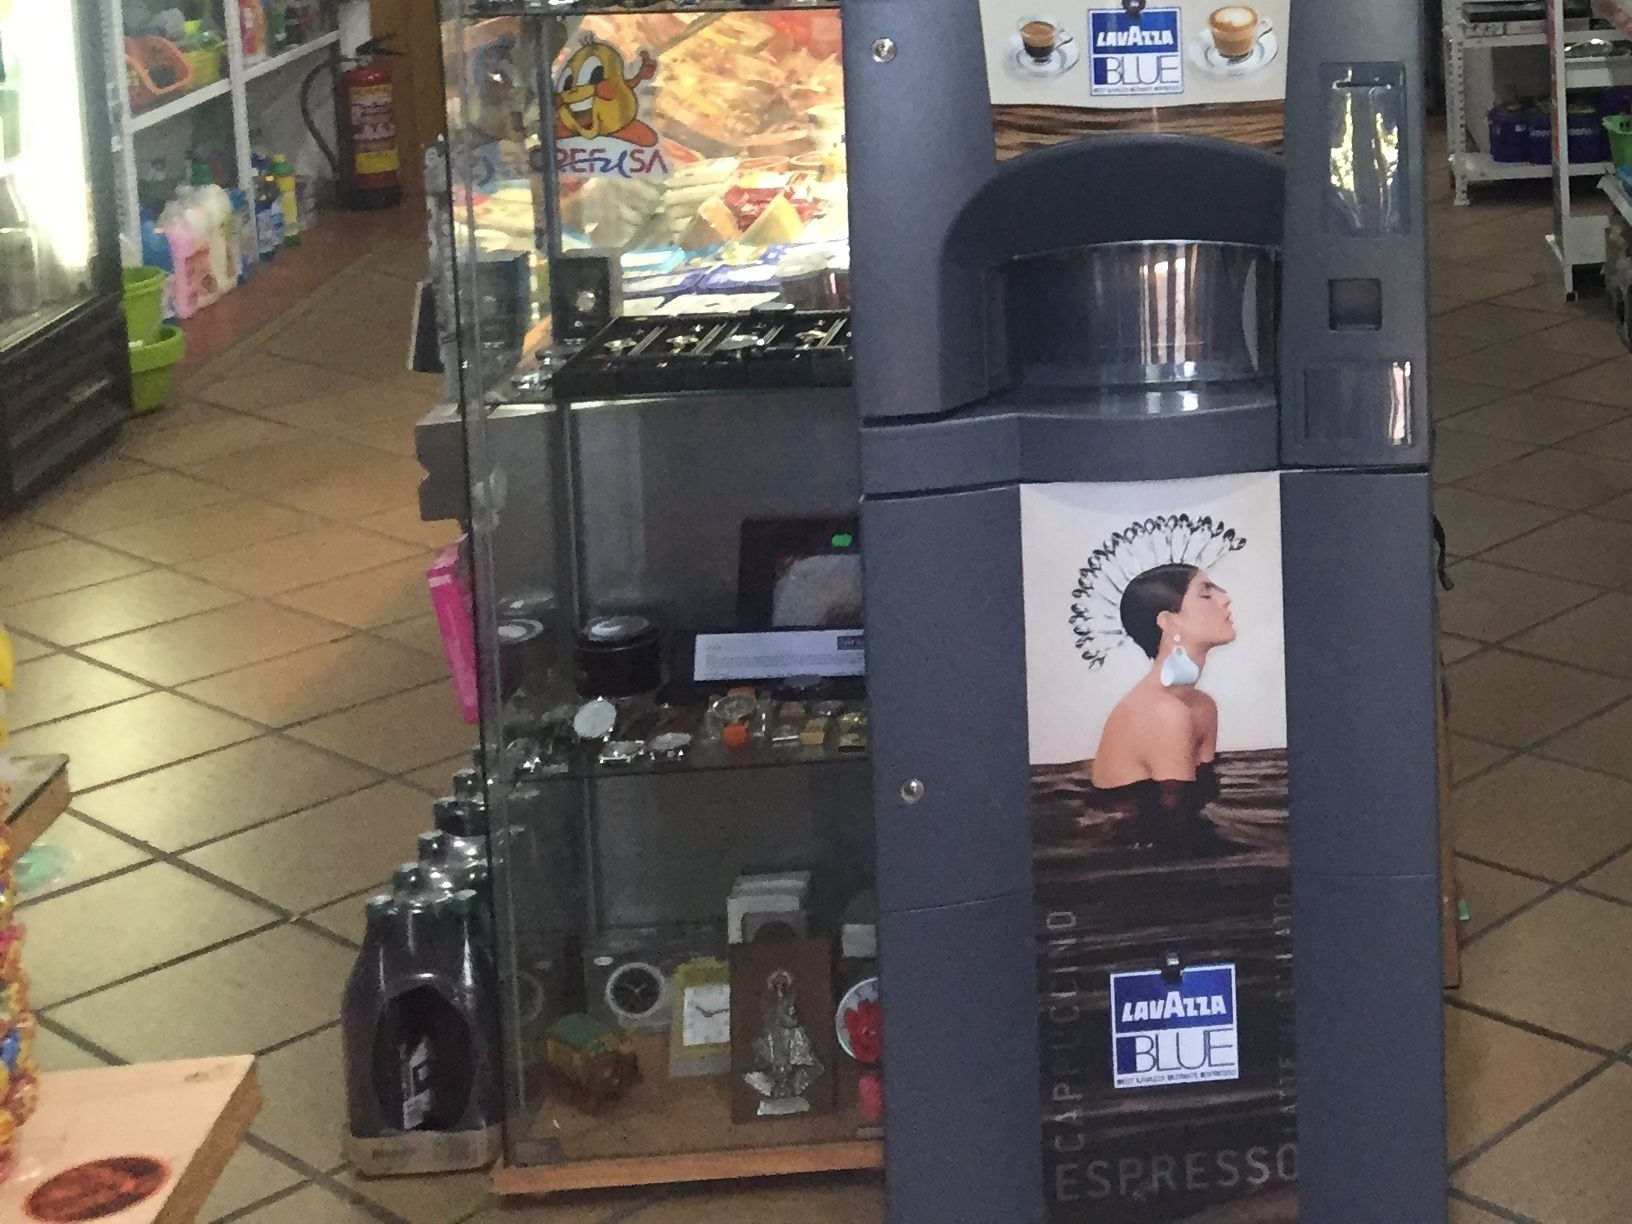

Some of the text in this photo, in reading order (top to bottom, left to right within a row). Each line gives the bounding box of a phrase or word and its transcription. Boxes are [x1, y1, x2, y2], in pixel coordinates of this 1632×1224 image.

[1096, 24, 1175, 48] LAVAZZA
[1093, 54, 1180, 86] BLUE
[555, 147, 669, 179] REFUSA
[1121, 990, 1227, 1024] LAVAZZA
[1116, 1027, 1236, 1075] BLUE
[1054, 1142, 1298, 1201] ESPRESSO
